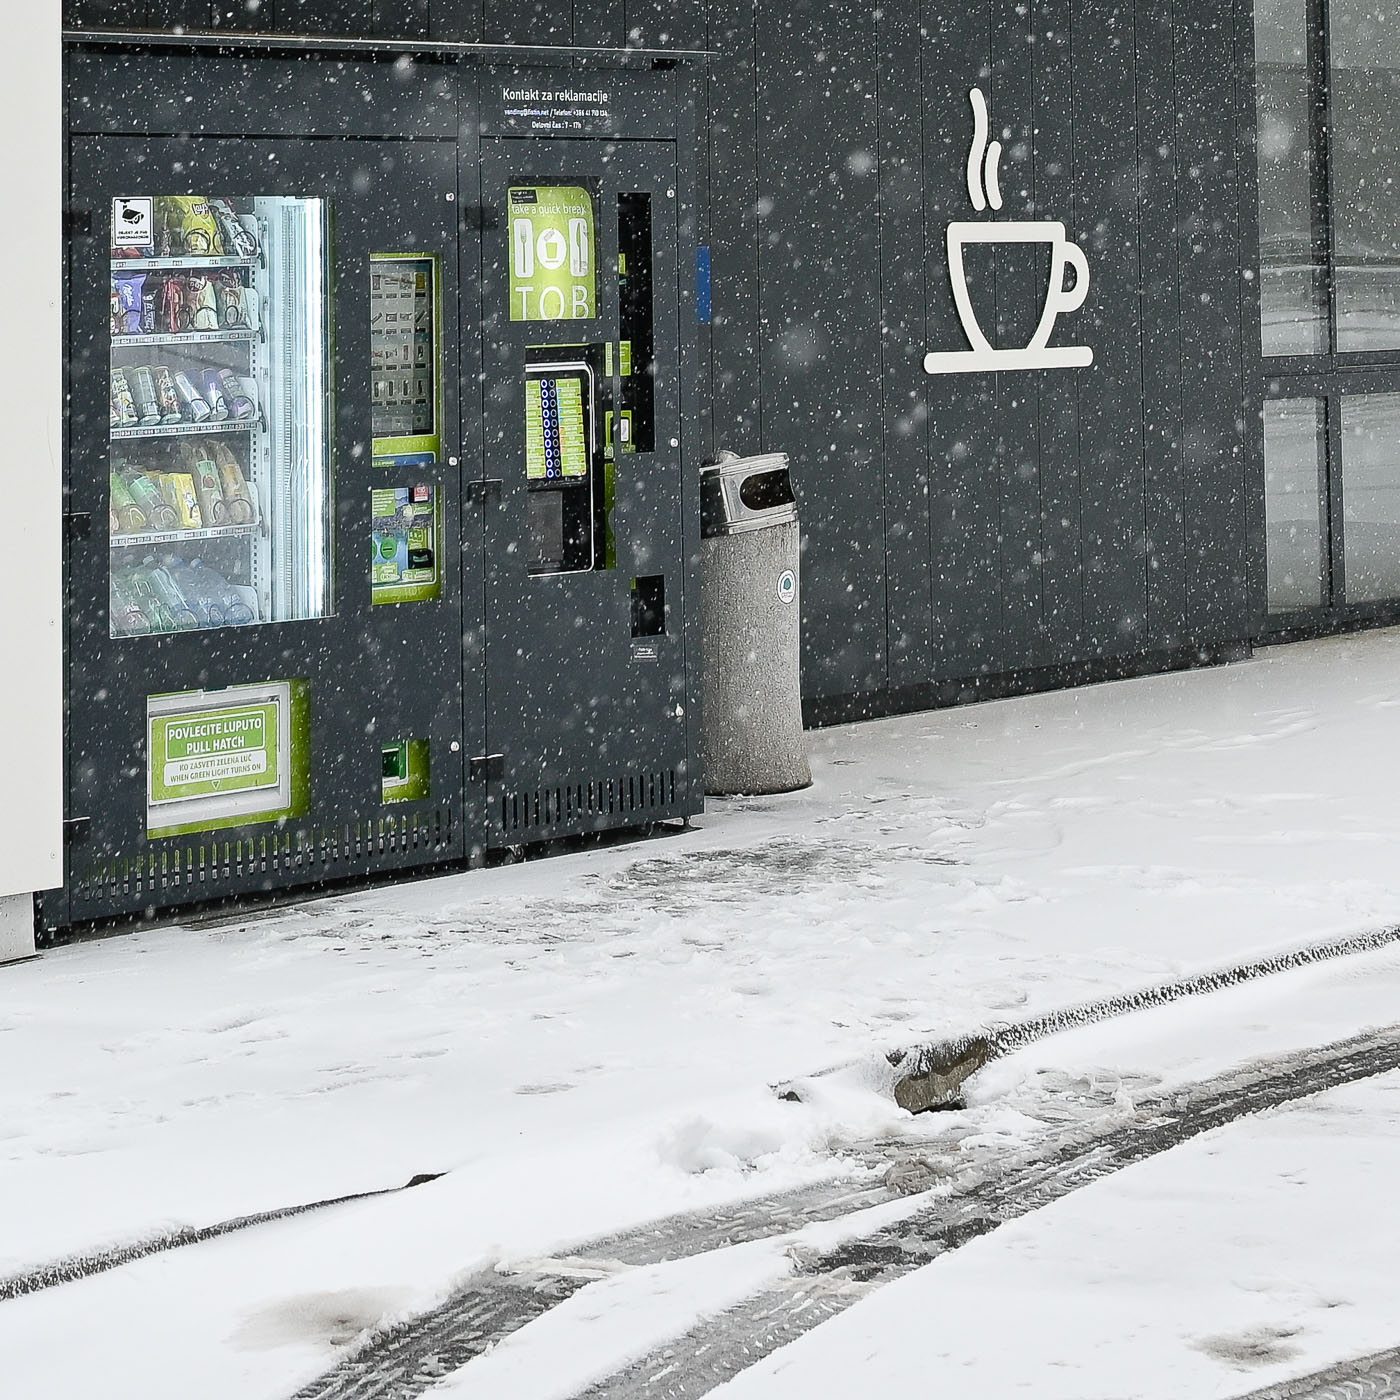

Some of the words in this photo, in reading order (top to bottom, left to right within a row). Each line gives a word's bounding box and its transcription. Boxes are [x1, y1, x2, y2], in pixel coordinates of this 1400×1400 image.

[503, 87, 540, 101] Kontakt
[541, 91, 553, 101] za
[555, 89, 609, 105] reklamacije
[512, 204, 530, 214] take
[531, 205, 537, 214] a
[538, 203, 561, 216] quick
[562, 203, 587, 216] break
[514, 285, 590, 320] TOB
[168, 723, 222, 741] POVLECITE
[223, 717, 262, 734] LUPUTO
[186, 740, 211, 755] PULL
[212, 735, 245, 751] HATCH
[170, 773, 189, 783] WHEN
[190, 769, 211, 780] GREEN
[211, 767, 230, 777] LIGHT
[230, 764, 251, 774] TURNS
[251, 762, 261, 771] ON
[179, 763, 189, 772] KO
[190, 759, 216, 770] ZASVETI
[216, 756, 240, 766] ZELENA
